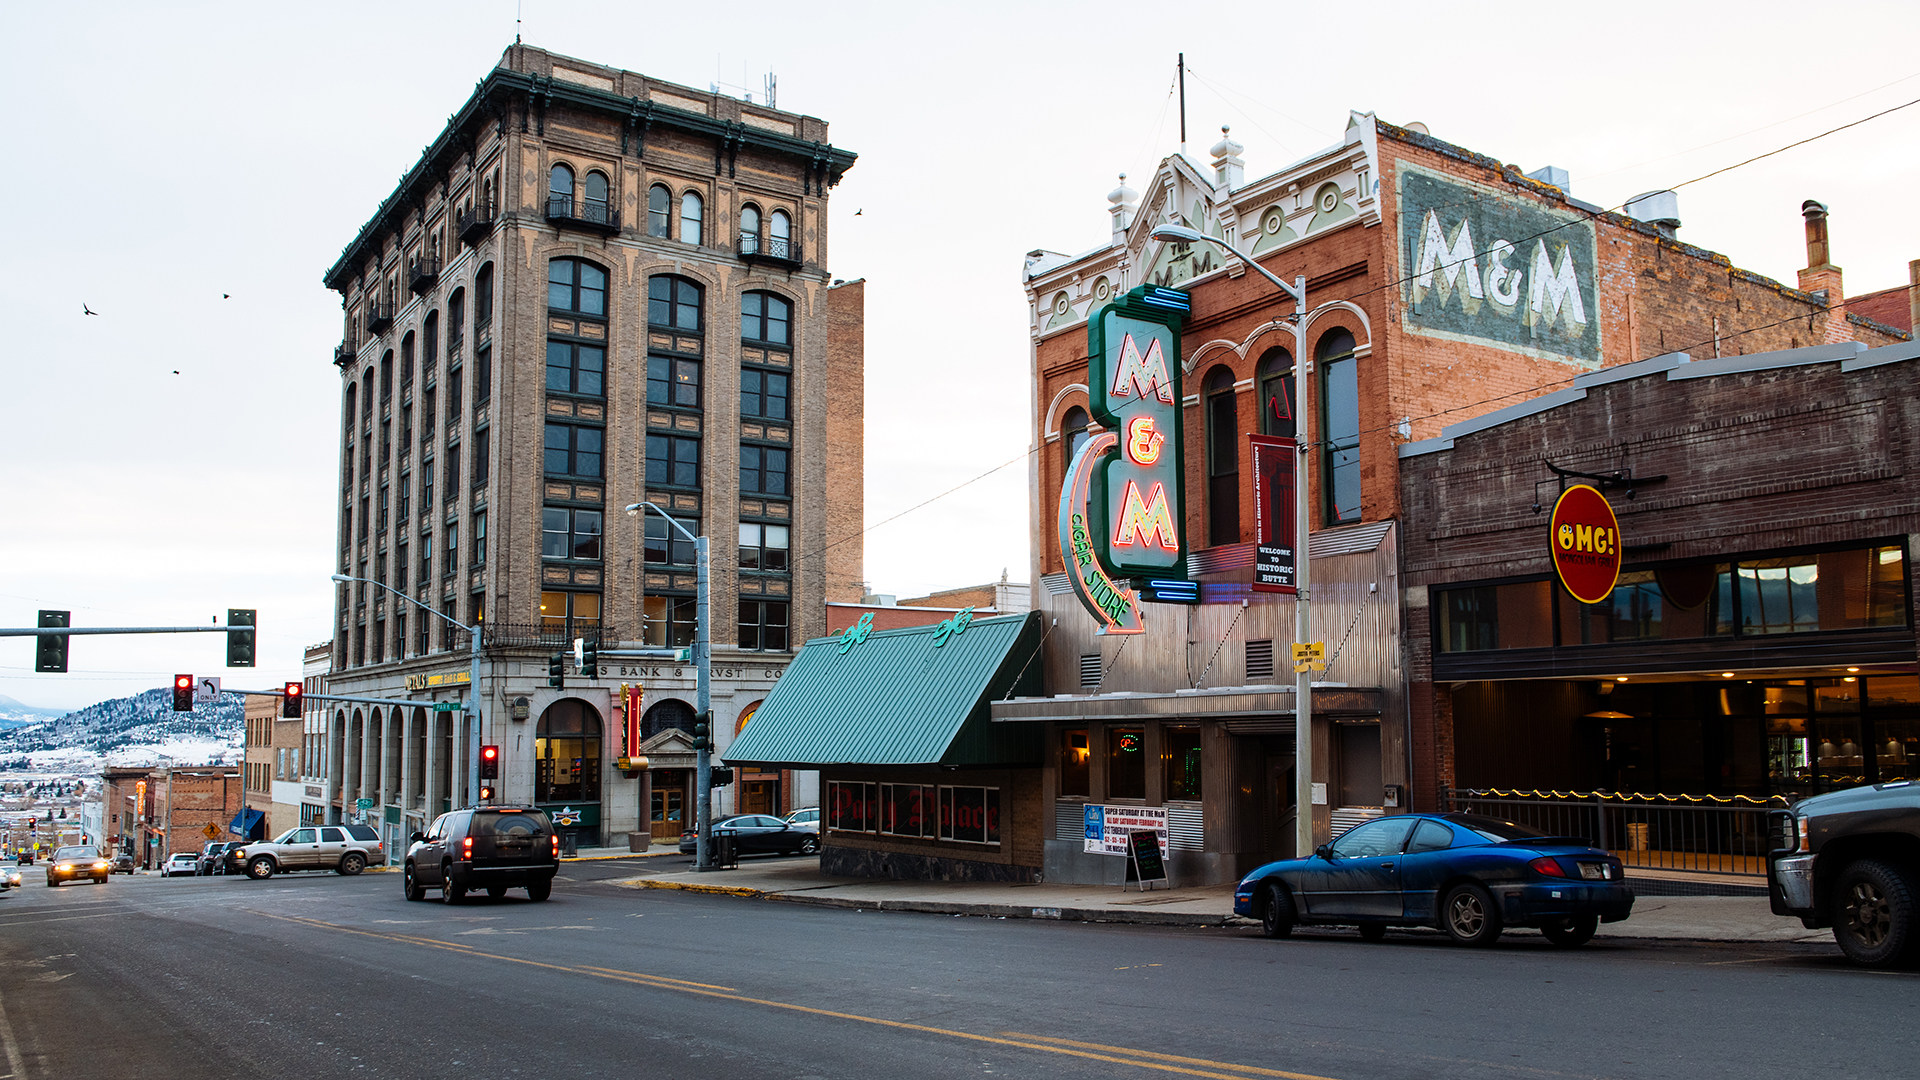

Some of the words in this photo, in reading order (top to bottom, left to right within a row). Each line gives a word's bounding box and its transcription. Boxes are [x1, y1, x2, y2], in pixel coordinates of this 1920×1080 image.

[1412, 207, 1587, 332] M&M
[1558, 523, 1614, 555] OMG!
[1259, 547, 1291, 556] WELCOME
[1559, 553, 1596, 566] MONGOLIAN
[1598, 556, 1615, 568] GRILL
[1072, 513, 1094, 568] CIGAR
[1084, 570, 1132, 627] STORE
[1257, 563, 1294, 574] HISTORIC
[1262, 574, 1288, 584] BUTTE
[620, 666, 662, 676] BANK
[674, 668, 683, 677] &
[710, 669, 743, 677] RVST
